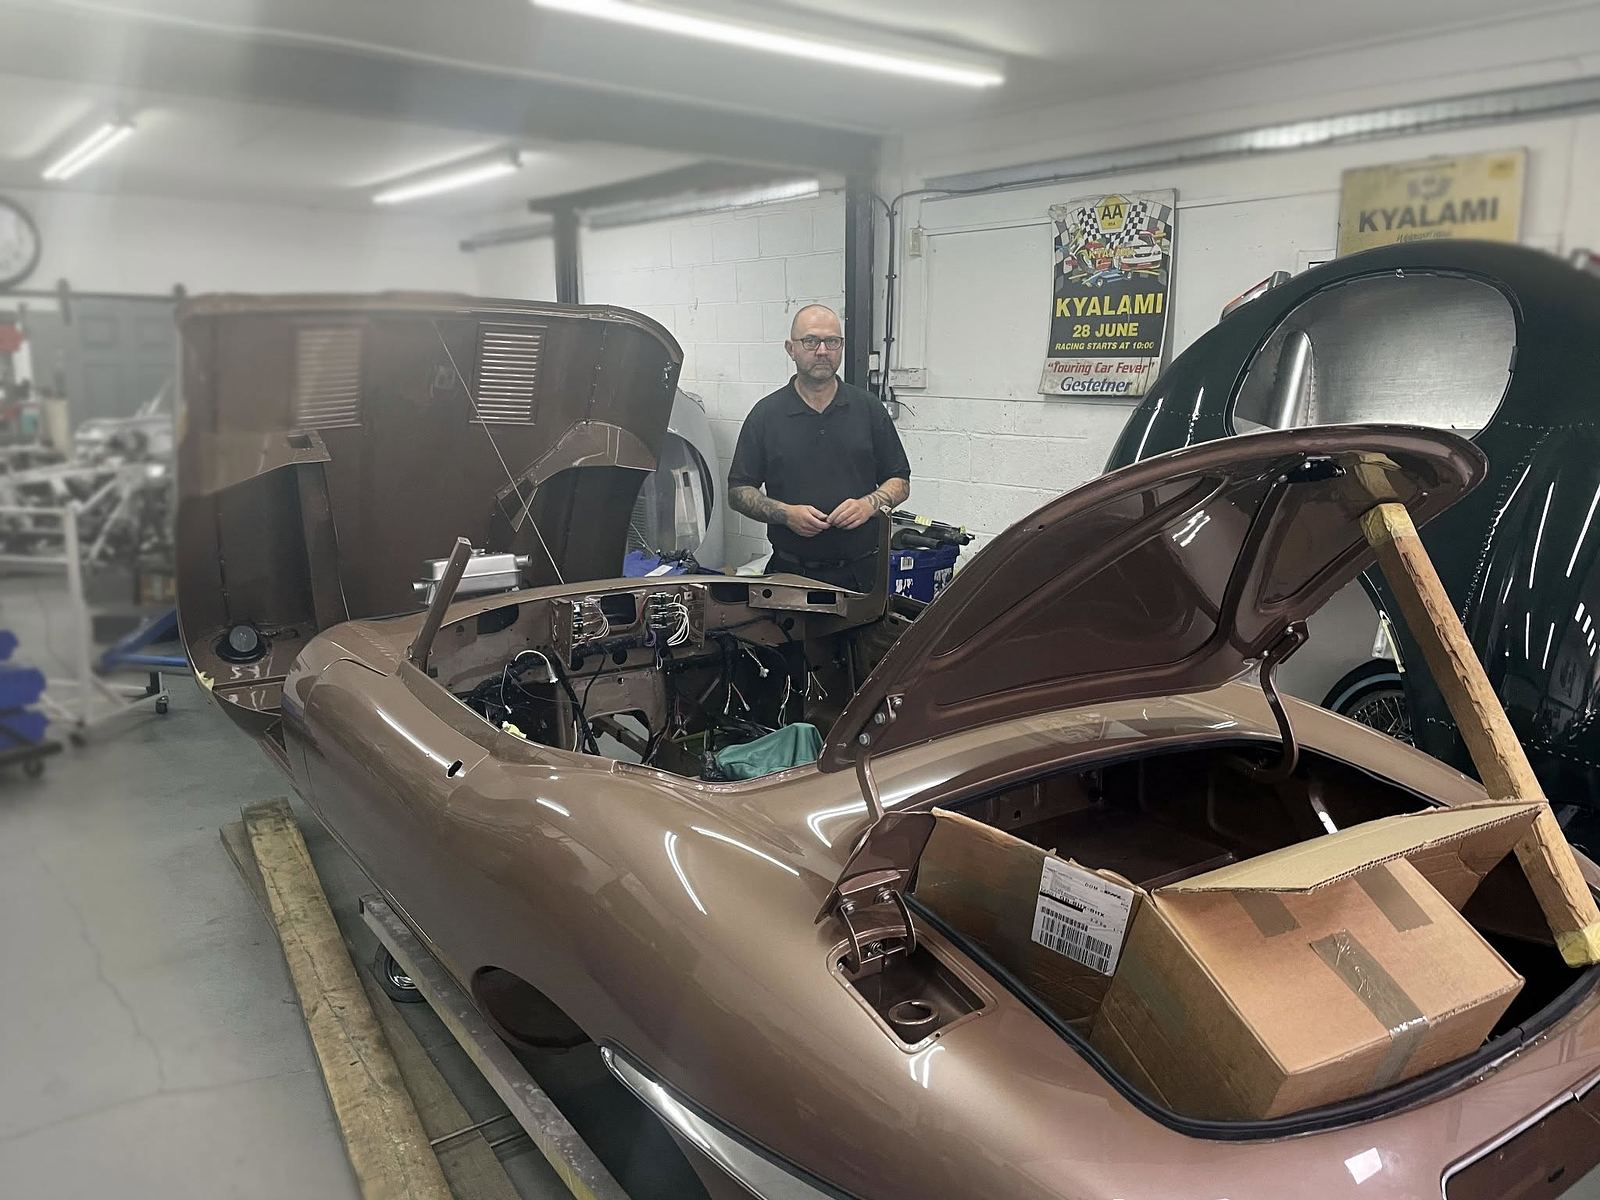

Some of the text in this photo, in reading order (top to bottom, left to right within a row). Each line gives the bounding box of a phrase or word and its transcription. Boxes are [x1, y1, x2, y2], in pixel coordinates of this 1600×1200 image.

[1101, 204, 1123, 220] AA
[1358, 197, 1499, 233] KYALAMI
[1055, 293, 1163, 317] KYALAMI
[1072, 322, 1139, 338] 28 JUNE
[1055, 341, 1154, 350] RACING STARTS AT 10:00
[1094, 362, 1114, 374] Car
[1060, 376, 1133, 393] Gestetner
